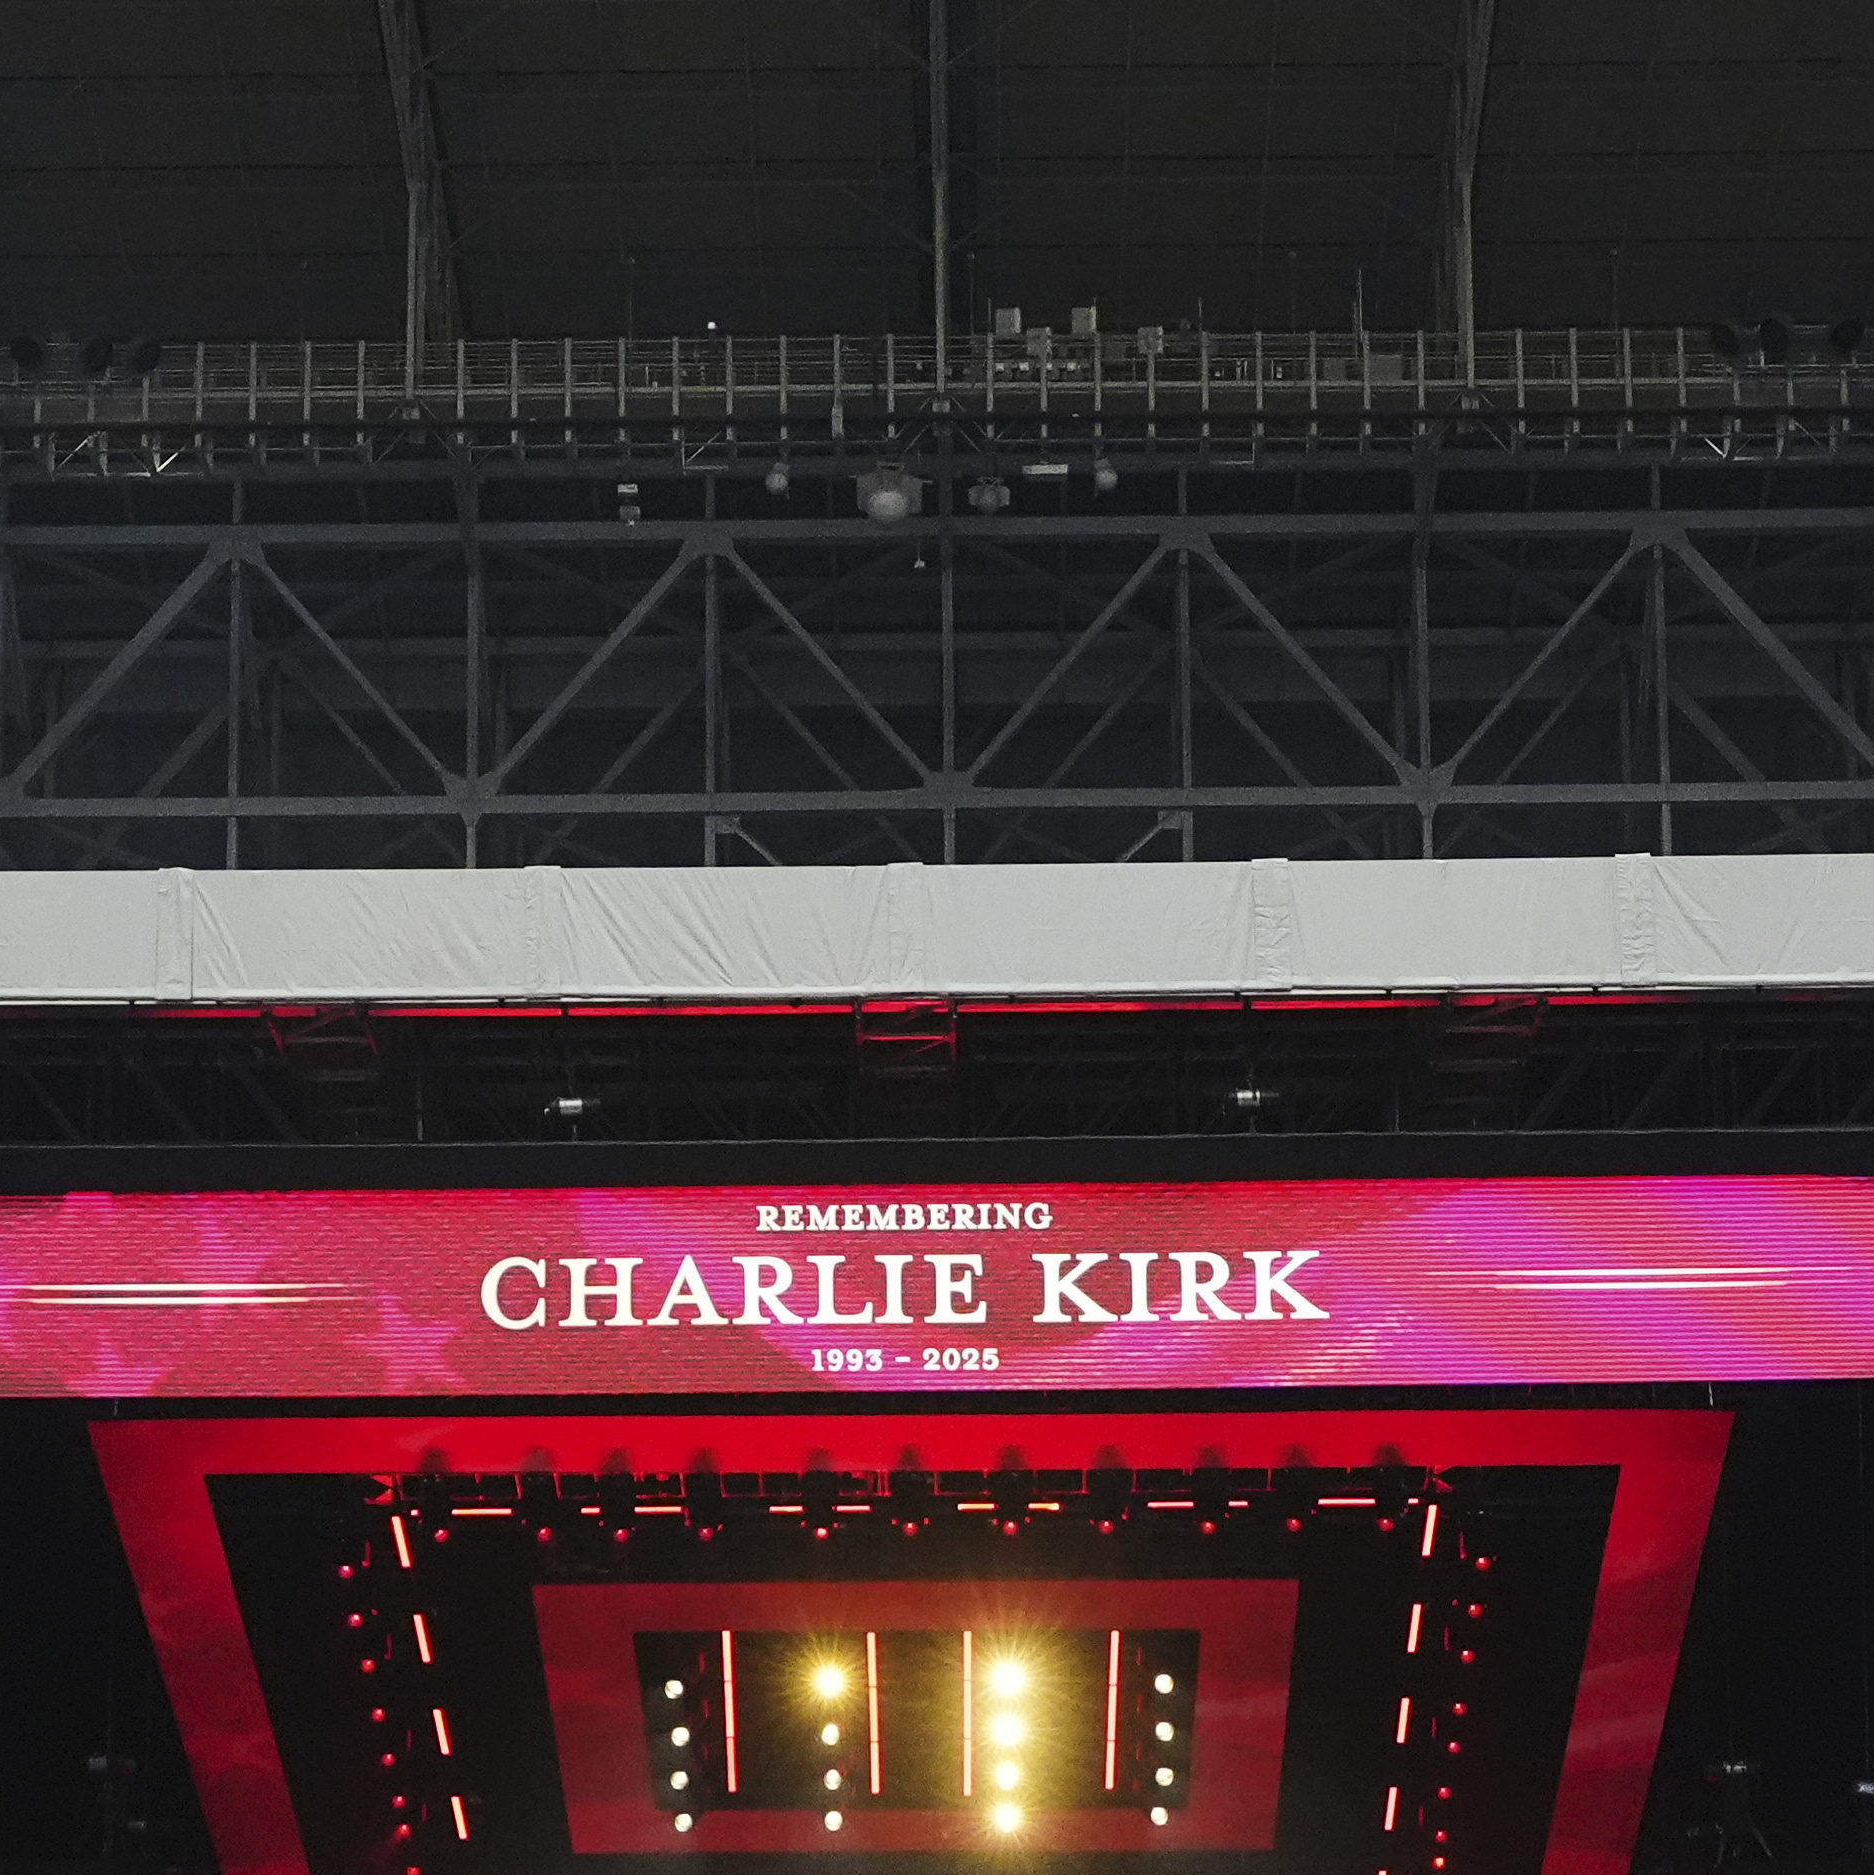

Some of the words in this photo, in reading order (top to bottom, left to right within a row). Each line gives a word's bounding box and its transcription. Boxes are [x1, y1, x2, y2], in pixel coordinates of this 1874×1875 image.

[756, 1202, 1053, 1232] REMEMBERING
[481, 1253, 987, 1330] CHARLIE
[1033, 1249, 1330, 1323] KIRK
[812, 1349, 883, 1372] 1993
[923, 1348, 999, 1371] 2025
